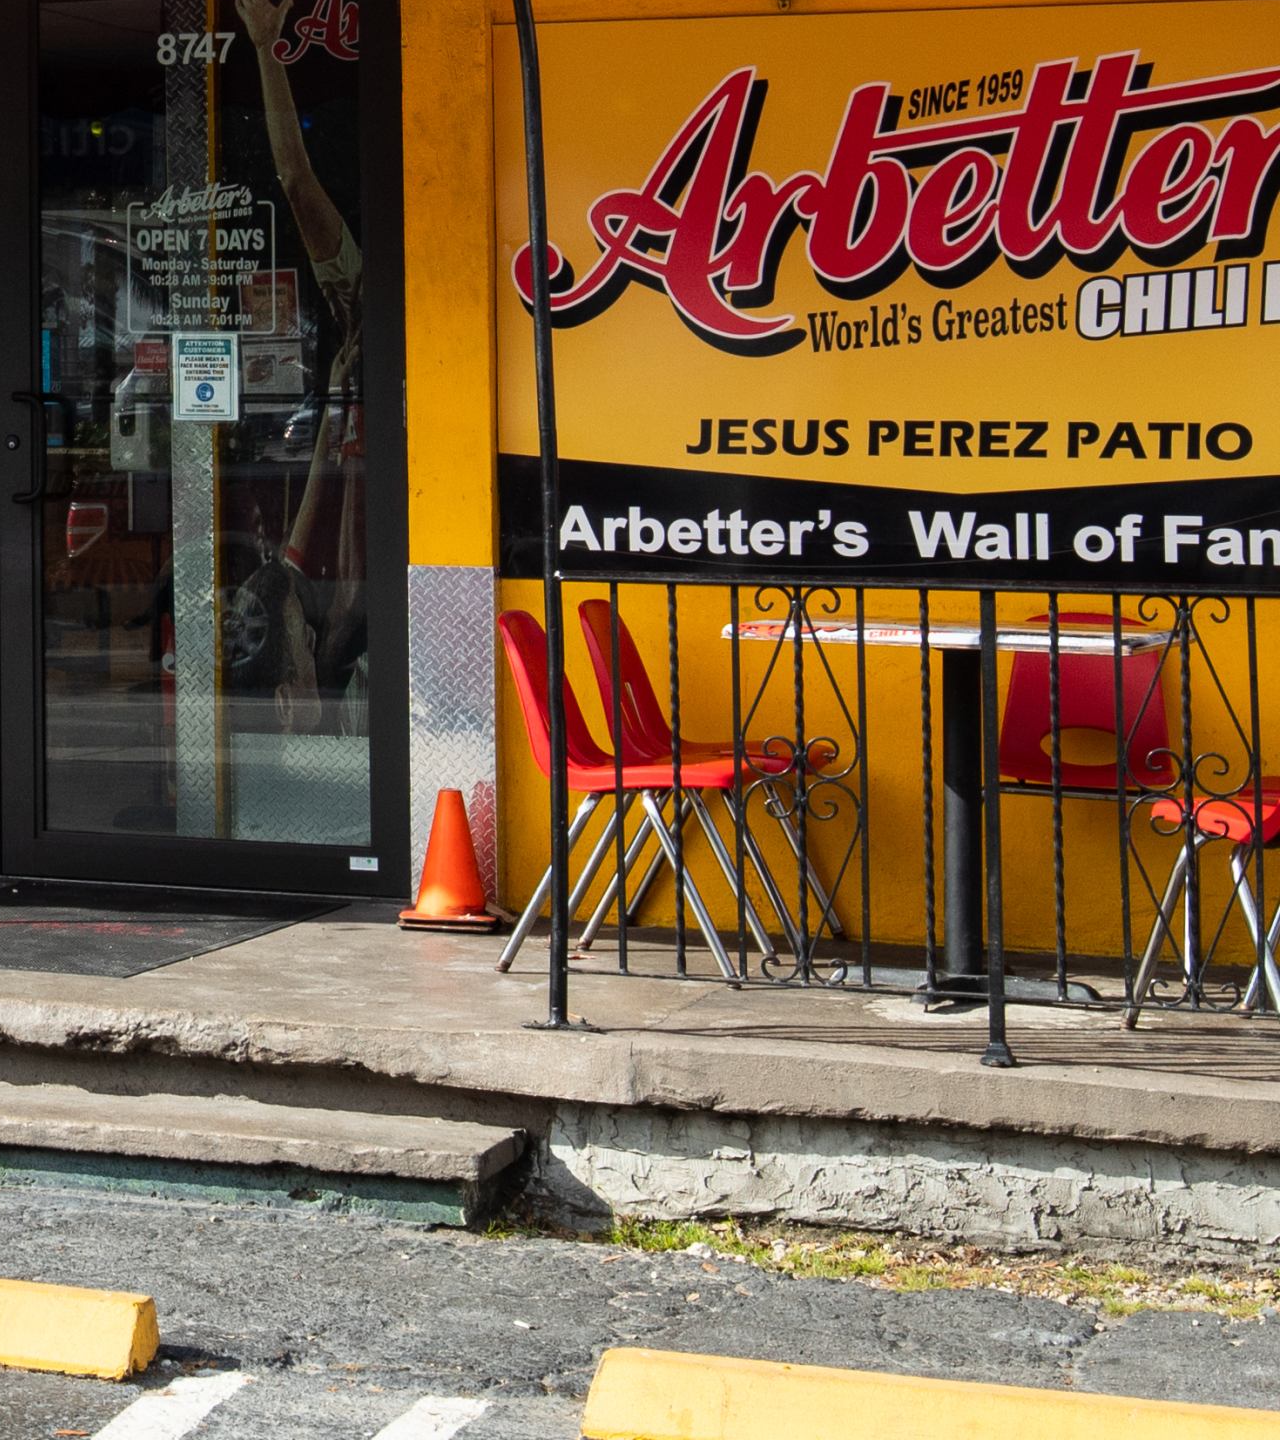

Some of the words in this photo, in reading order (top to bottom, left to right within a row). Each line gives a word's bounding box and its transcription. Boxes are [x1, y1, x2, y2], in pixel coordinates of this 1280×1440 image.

[157, 33, 235, 66] 8747
[907, 80, 969, 121] SINCE
[976, 68, 1024, 108] 1959
[140, 183, 253, 223] Arbetter's
[212, 209, 232, 222] CHILI
[233, 205, 253, 218] DOGS
[511, 48, 1280, 358] Arbetter
[137, 228, 190, 252] OPEN
[197, 228, 208, 251] 7
[216, 228, 265, 252] DAYS
[142, 258, 191, 273] Monday
[201, 257, 260, 273] Saturday
[149, 274, 179, 287] 10:28
[182, 274, 201, 286] AM
[209, 274, 233, 286] 9:01
[234, 274, 254, 286] PM
[171, 292, 231, 312] Sunday
[807, 301, 922, 355] World's
[931, 292, 1069, 343] Greatest
[1076, 262, 1249, 343] CHILI
[149, 314, 180, 327] 10:28
[182, 314, 201, 326] AM
[209, 314, 233, 326] 7:01
[234, 313, 254, 326] PM
[686, 417, 851, 456] JESUS
[867, 420, 1049, 459] PEREZ
[1067, 421, 1254, 462] PATIO
[560, 504, 869, 559] Arbetter's
[908, 509, 1050, 562] Wall
[1074, 514, 1142, 562] of
